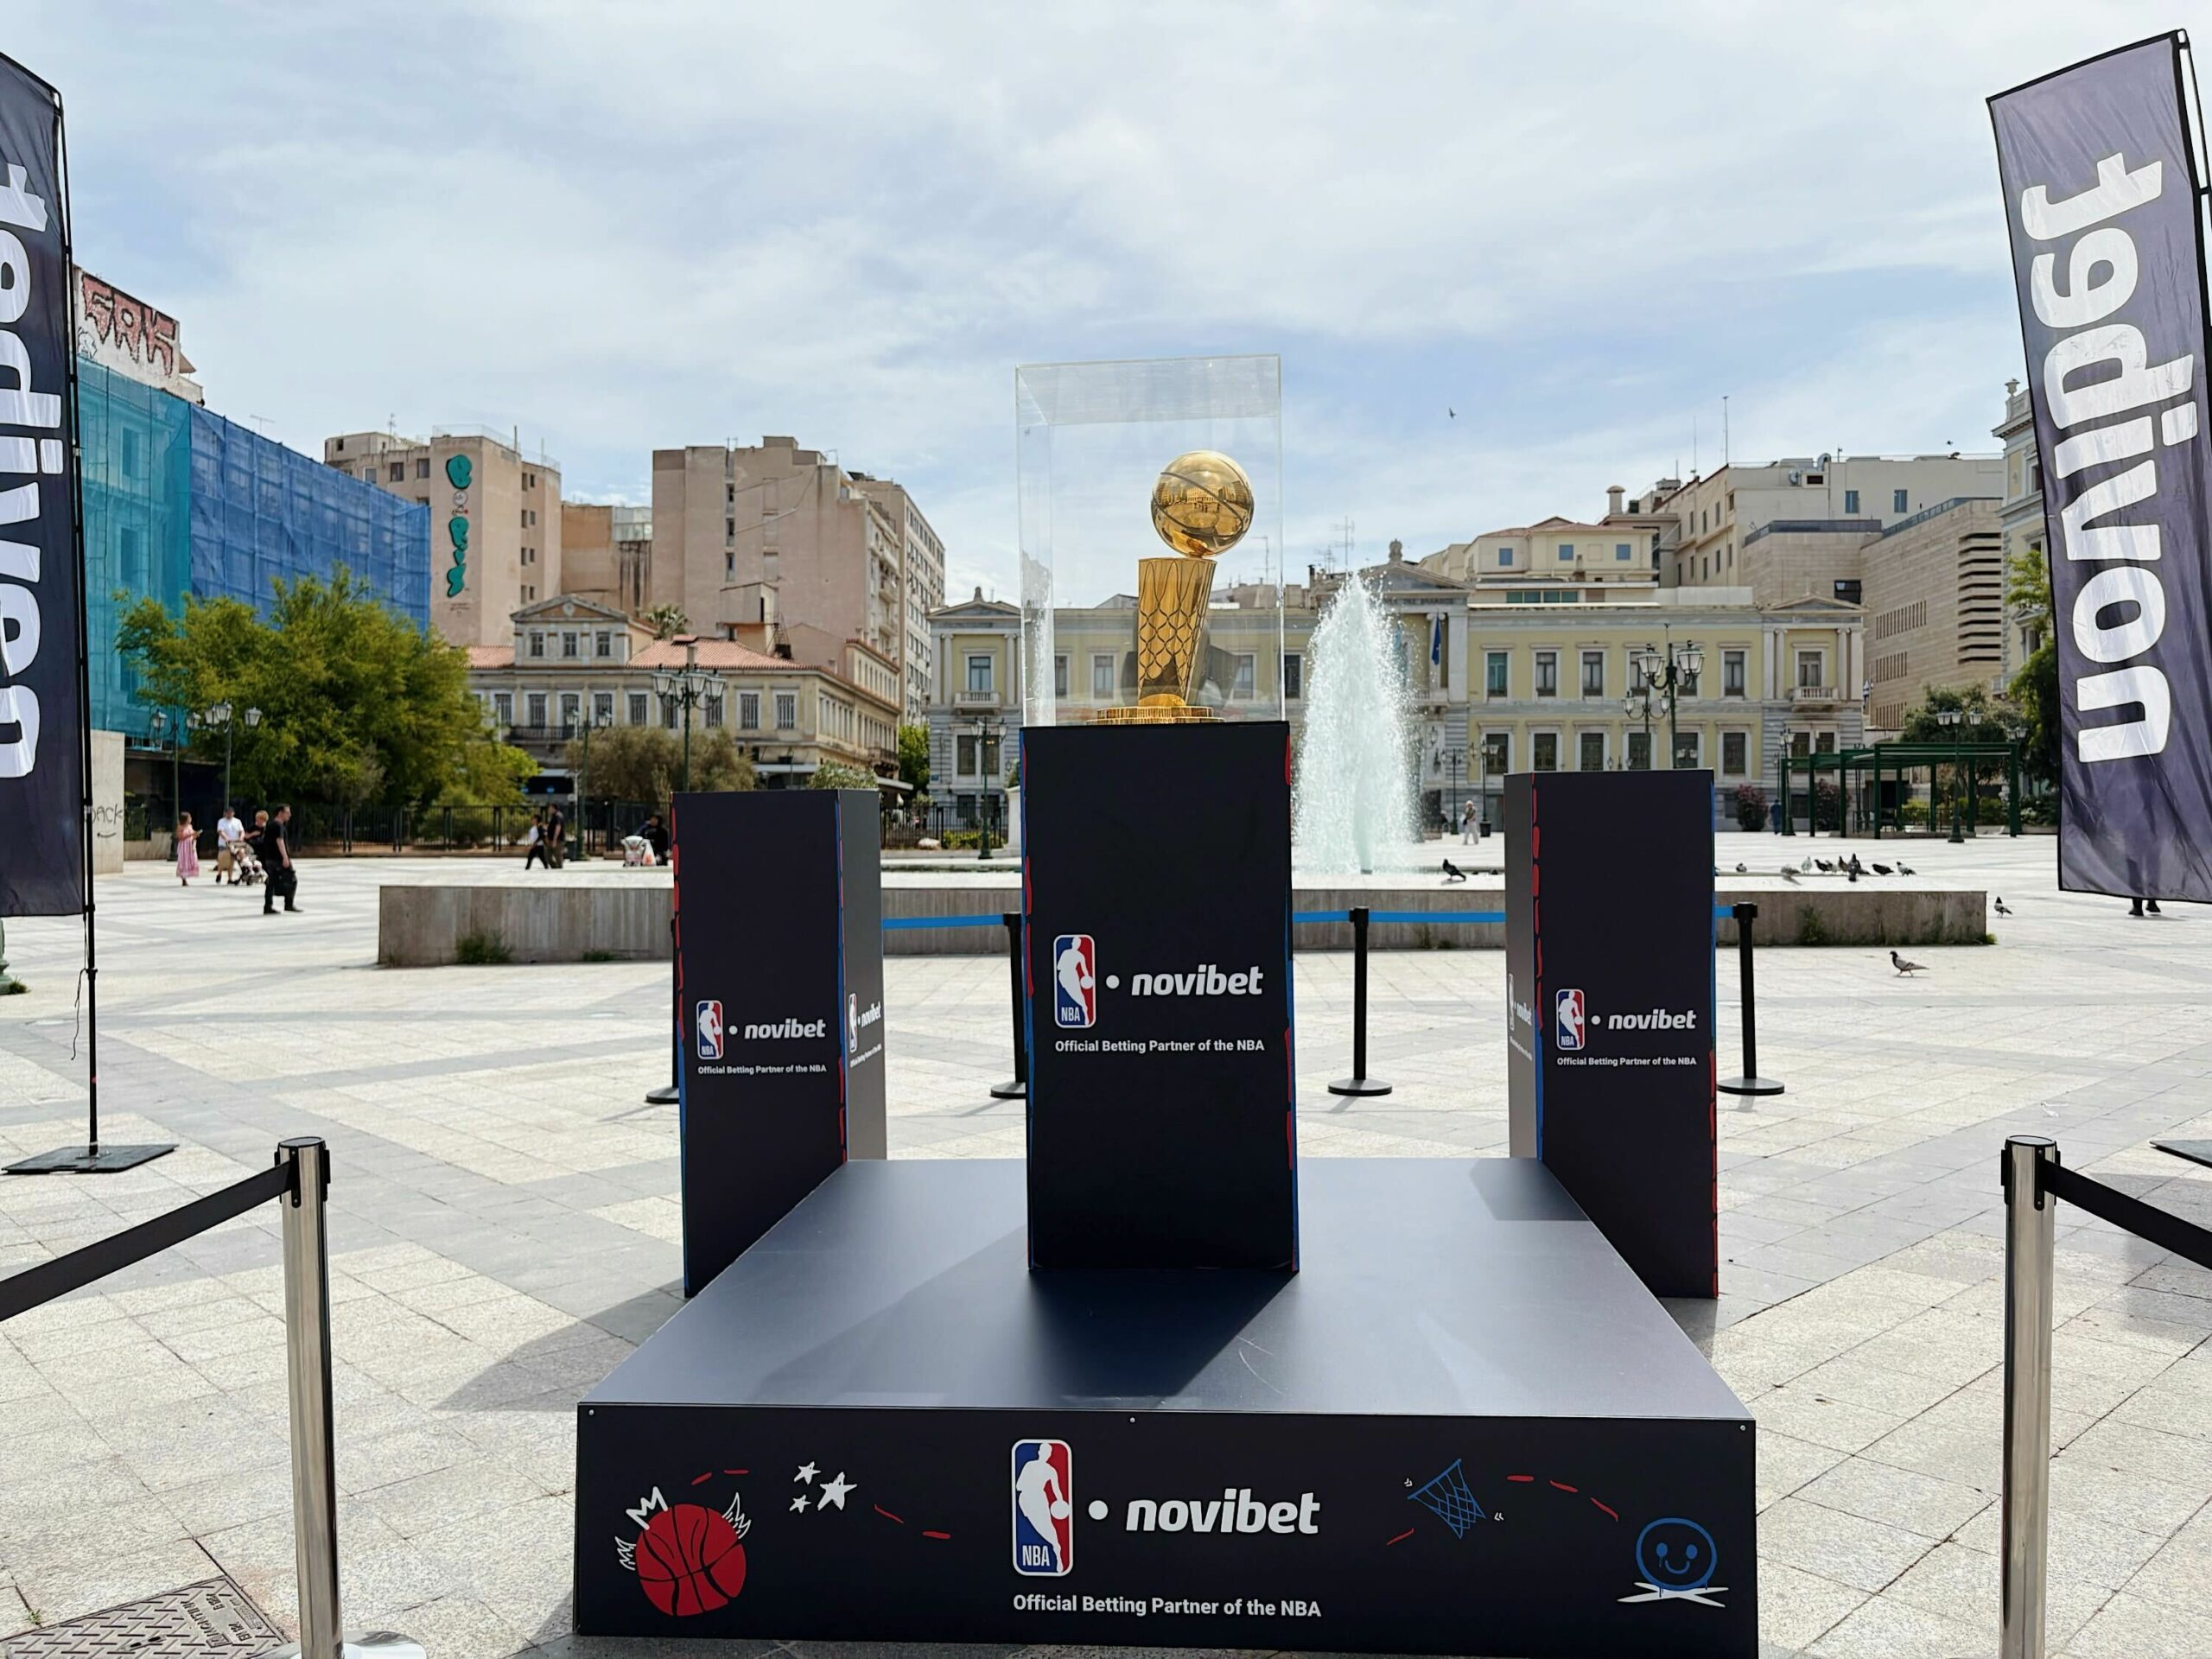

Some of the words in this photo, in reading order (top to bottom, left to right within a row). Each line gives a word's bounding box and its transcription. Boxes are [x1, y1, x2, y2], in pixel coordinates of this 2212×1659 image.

[1131, 963, 1264, 996] novibet
[1061, 1007, 1080, 1022] NBA
[1608, 1008, 1697, 1030] novibet
[744, 1018, 826, 1039] novibet
[1055, 1039, 1099, 1052] Official
[1102, 1039, 1147, 1054] Betting
[1148, 1039, 1196, 1052] Partner
[1198, 1039, 1211, 1052] of
[1213, 1039, 1235, 1052] the
[1236, 1039, 1265, 1052] NBA
[1561, 1036, 1575, 1046] NBA
[701, 1045, 715, 1056] NBA
[697, 1065, 726, 1075] Official
[726, 1065, 754, 1076] Betting
[755, 1065, 785, 1074] Partner
[785, 1065, 794, 1074] of
[795, 1065, 808, 1073] the
[809, 1064, 827, 1073] NBA
[1556, 1057, 1587, 1065] Official
[1588, 1057, 1618, 1067] Betting
[1619, 1057, 1651, 1065] Partner
[1651, 1057, 1662, 1065] of
[1662, 1057, 1676, 1065] the
[1677, 1057, 1697, 1065] NBA
[1126, 1488, 1321, 1535] novibet
[1022, 1545, 1050, 1567] NBA
[1014, 1594, 1077, 1611] Official
[1083, 1596, 1146, 1616] Betting
[1153, 1598, 1218, 1614] Partner
[1224, 1599, 1242, 1614] of
[1247, 1599, 1275, 1615] the
[1281, 1601, 1321, 1617] NBA
